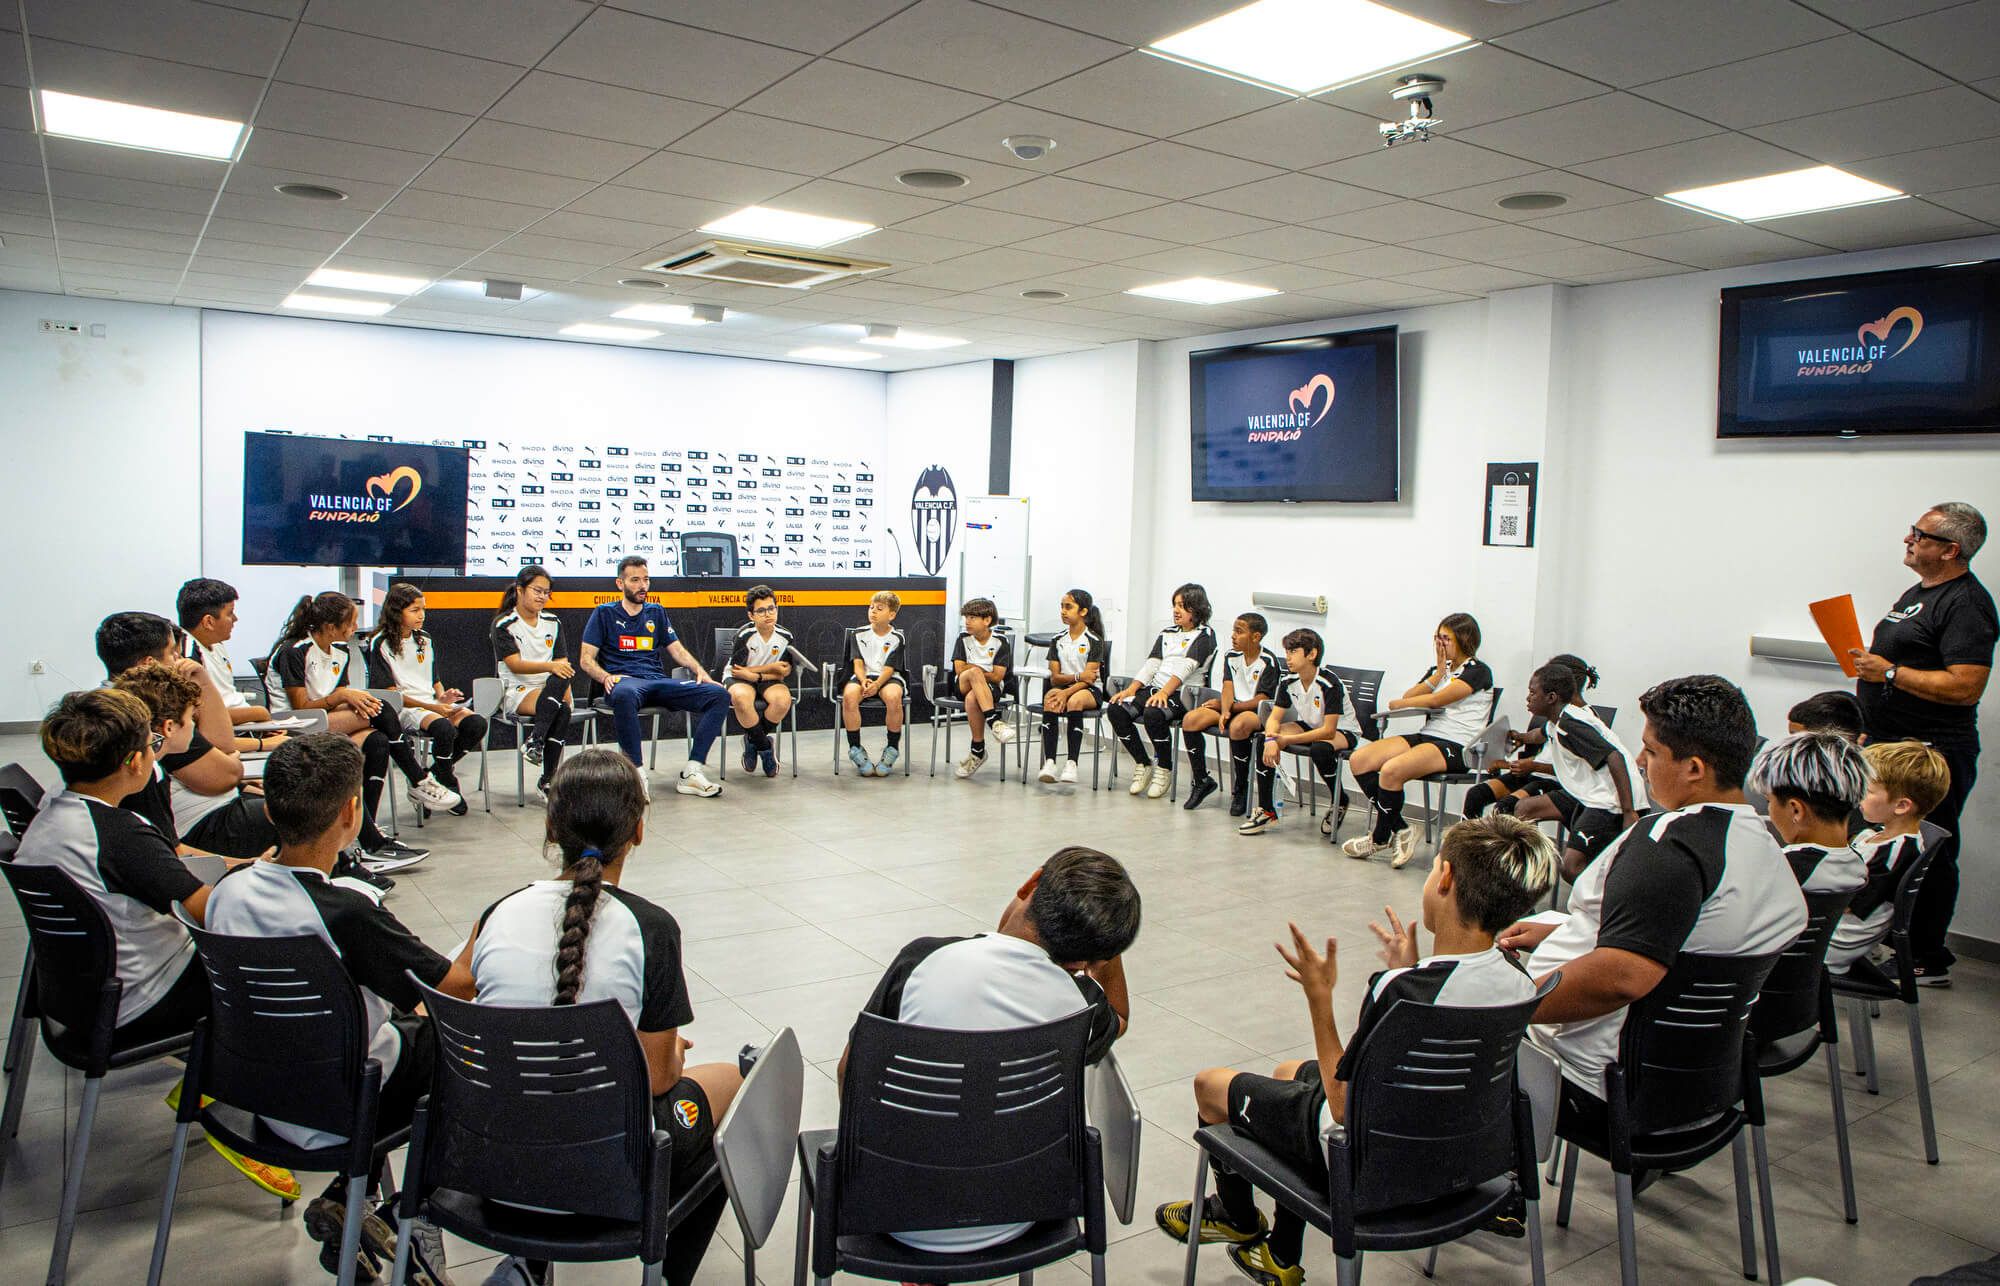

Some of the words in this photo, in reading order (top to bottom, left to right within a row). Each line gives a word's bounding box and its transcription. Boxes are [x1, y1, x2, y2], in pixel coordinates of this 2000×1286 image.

[1798, 347, 1864, 364] VALENCIA
[1869, 345, 1887, 360] CF
[1797, 360, 1873, 376] FUNDACIÓ
[1248, 413, 1295, 430] VALENCIA
[1298, 412, 1311, 427] CF
[1248, 427, 1302, 443] FUNDACIÓ
[310, 495, 373, 510] VALENCIA
[377, 498, 392, 512] CF
[309, 511, 380, 522] FUNDACIÓ
[594, 596, 620, 604] CIUDAD
[709, 595, 740, 603] VALENCIA
[776, 594, 795, 603] UTBOL
[622, 639, 635, 647] TM
